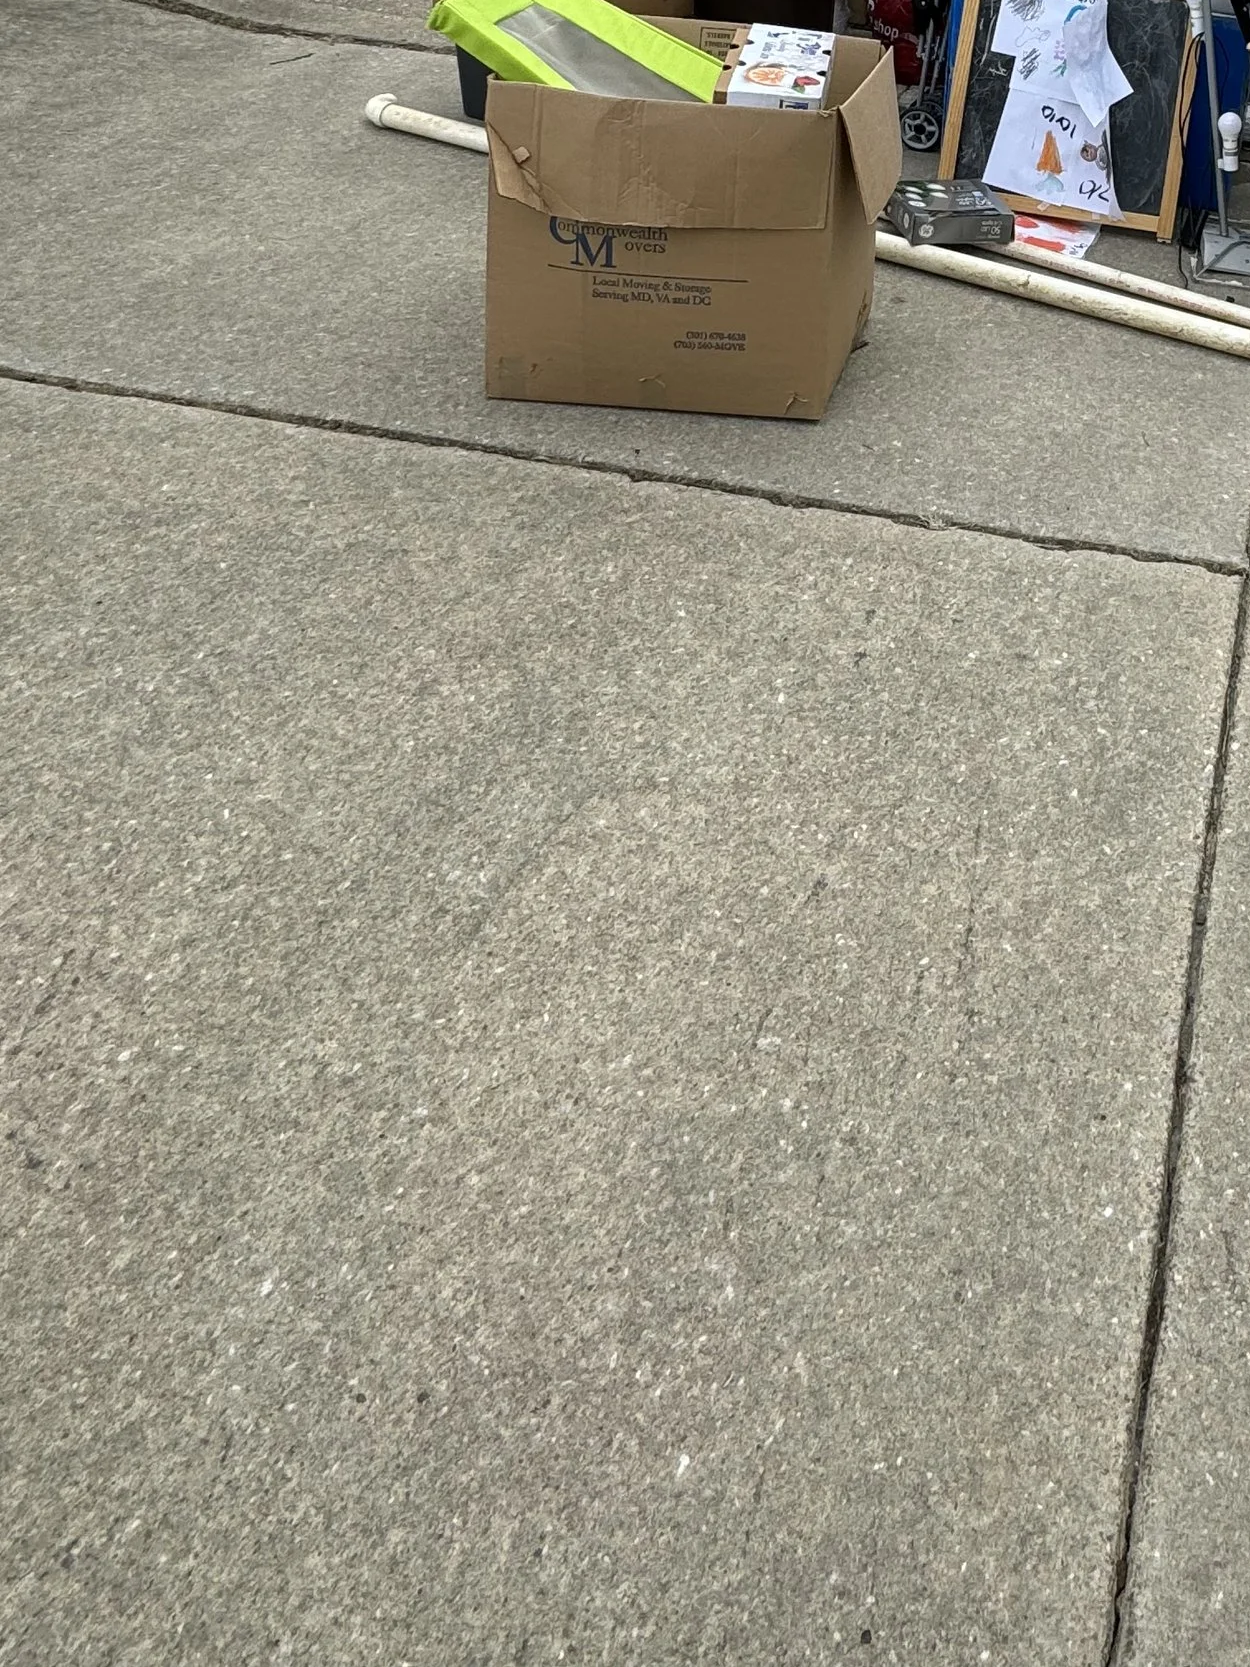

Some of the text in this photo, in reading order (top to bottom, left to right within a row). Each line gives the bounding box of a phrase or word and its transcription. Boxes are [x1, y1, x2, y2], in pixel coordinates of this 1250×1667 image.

[550, 216, 668, 245] Commonwealth
[592, 276, 712, 295] Local Moving & Storage
[592, 288, 712, 306] Serving MD, VA and DC
